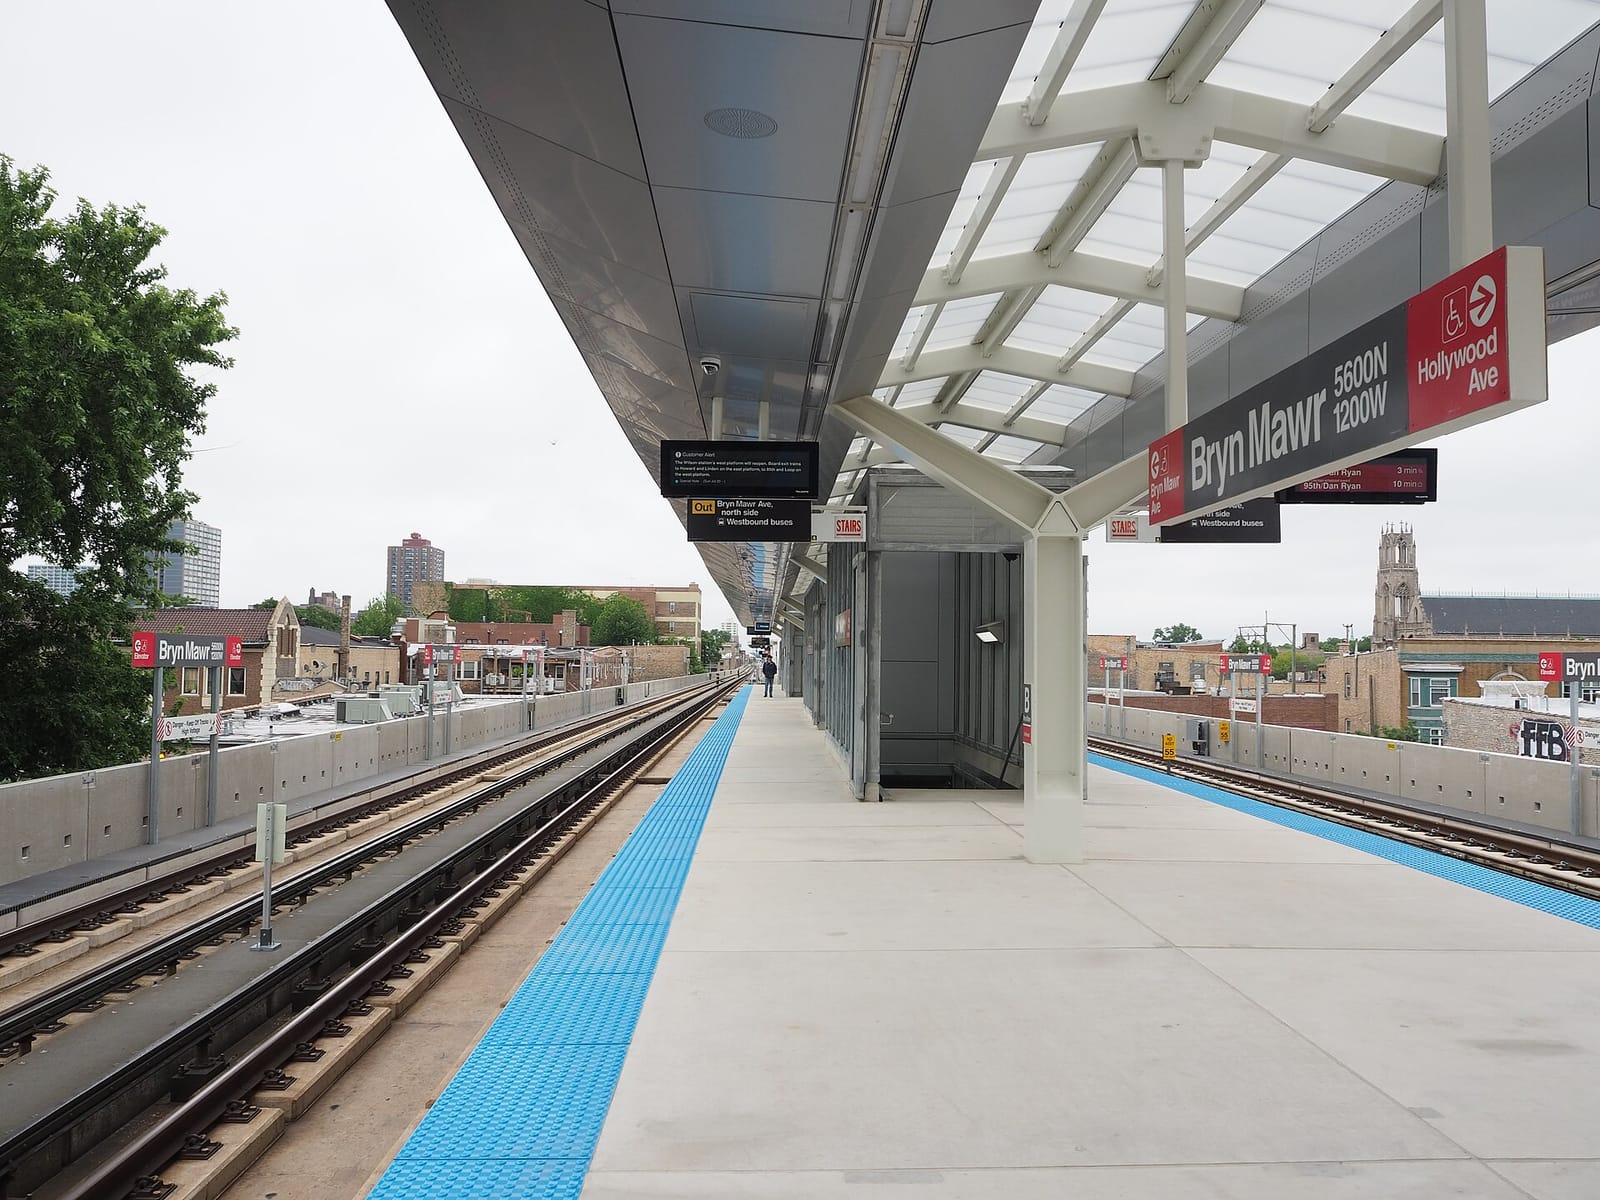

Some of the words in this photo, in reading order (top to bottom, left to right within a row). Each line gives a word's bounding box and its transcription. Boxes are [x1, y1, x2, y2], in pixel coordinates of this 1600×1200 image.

[1418, 326, 1498, 384] Hollywood
[1333, 341, 1387, 398] 5600N
[1468, 366, 1498, 396] Ave
[1332, 380, 1388, 434] 1200W
[1191, 430, 1244, 497] Bryn
[1248, 388, 1326, 469] Mawr
[1341, 468, 1362, 476] Ryan
[1150, 481, 1164, 498] Bryn
[1163, 475, 1180, 492] Mawr
[1341, 482, 1361, 491] Ryan
[694, 502, 712, 512] Out
[717, 500, 735, 509] Bryn
[1150, 500, 1161, 514] Ave
[836, 520, 861, 533] STAIRS
[1112, 520, 1136, 534] STAIRS
[160, 640, 184, 665] Bryn
[185, 641, 210, 660] Mawr
[1566, 658, 1595, 681] Bryn
